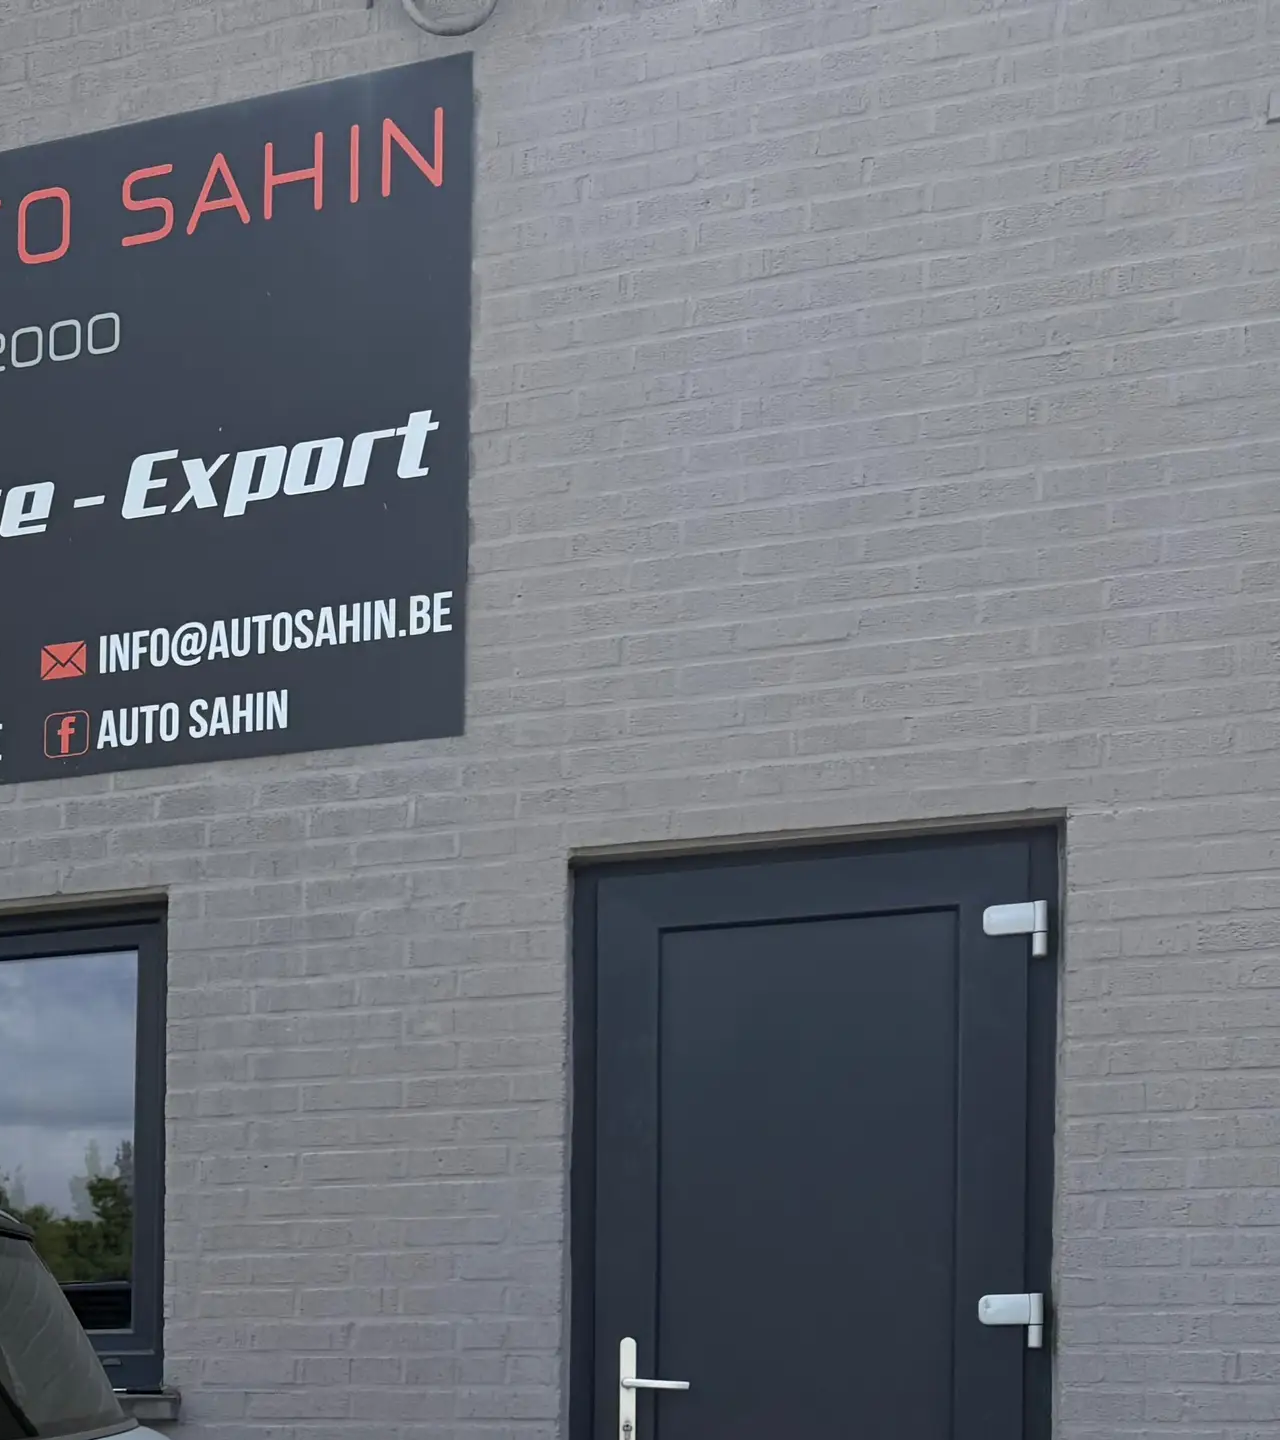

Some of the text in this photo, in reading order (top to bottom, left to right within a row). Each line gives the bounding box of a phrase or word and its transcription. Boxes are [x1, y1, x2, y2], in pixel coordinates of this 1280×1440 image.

[121, 107, 444, 247] SAHIN
[73, 494, 107, 508] -
[121, 410, 440, 519] Export
[98, 591, 453, 674] INFO@AUTOSAHIN.BE
[96, 702, 180, 751] AUTO
[188, 689, 289, 740] SAHIN
